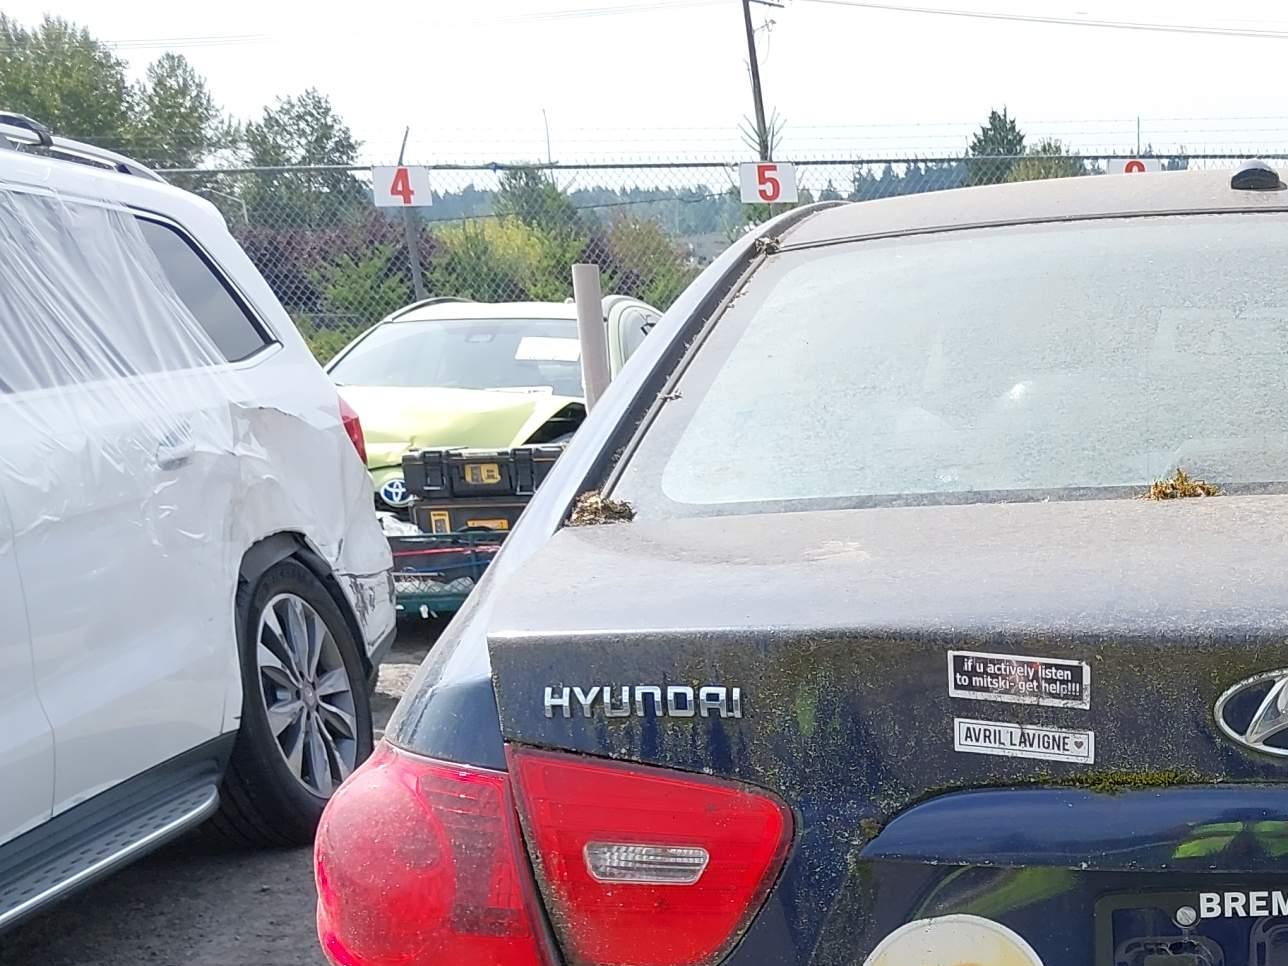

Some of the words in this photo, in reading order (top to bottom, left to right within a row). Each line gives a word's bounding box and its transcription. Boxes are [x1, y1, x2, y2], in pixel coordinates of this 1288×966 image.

[390, 167, 415, 204] 4
[757, 164, 781, 202] 5
[962, 658, 973, 672] if
[976, 663, 984, 673] u
[986, 661, 1035, 680] actively
[1038, 662, 1072, 680] listen
[955, 674, 969, 686] to
[972, 674, 1015, 690] mitski-
[1018, 681, 1039, 694] get
[1041, 680, 1080, 698] help!!!
[544, 685, 743, 719] HYUNDAI
[964, 726, 1006, 747] AVRIL
[1009, 730, 1071, 752] LAVIGNE
